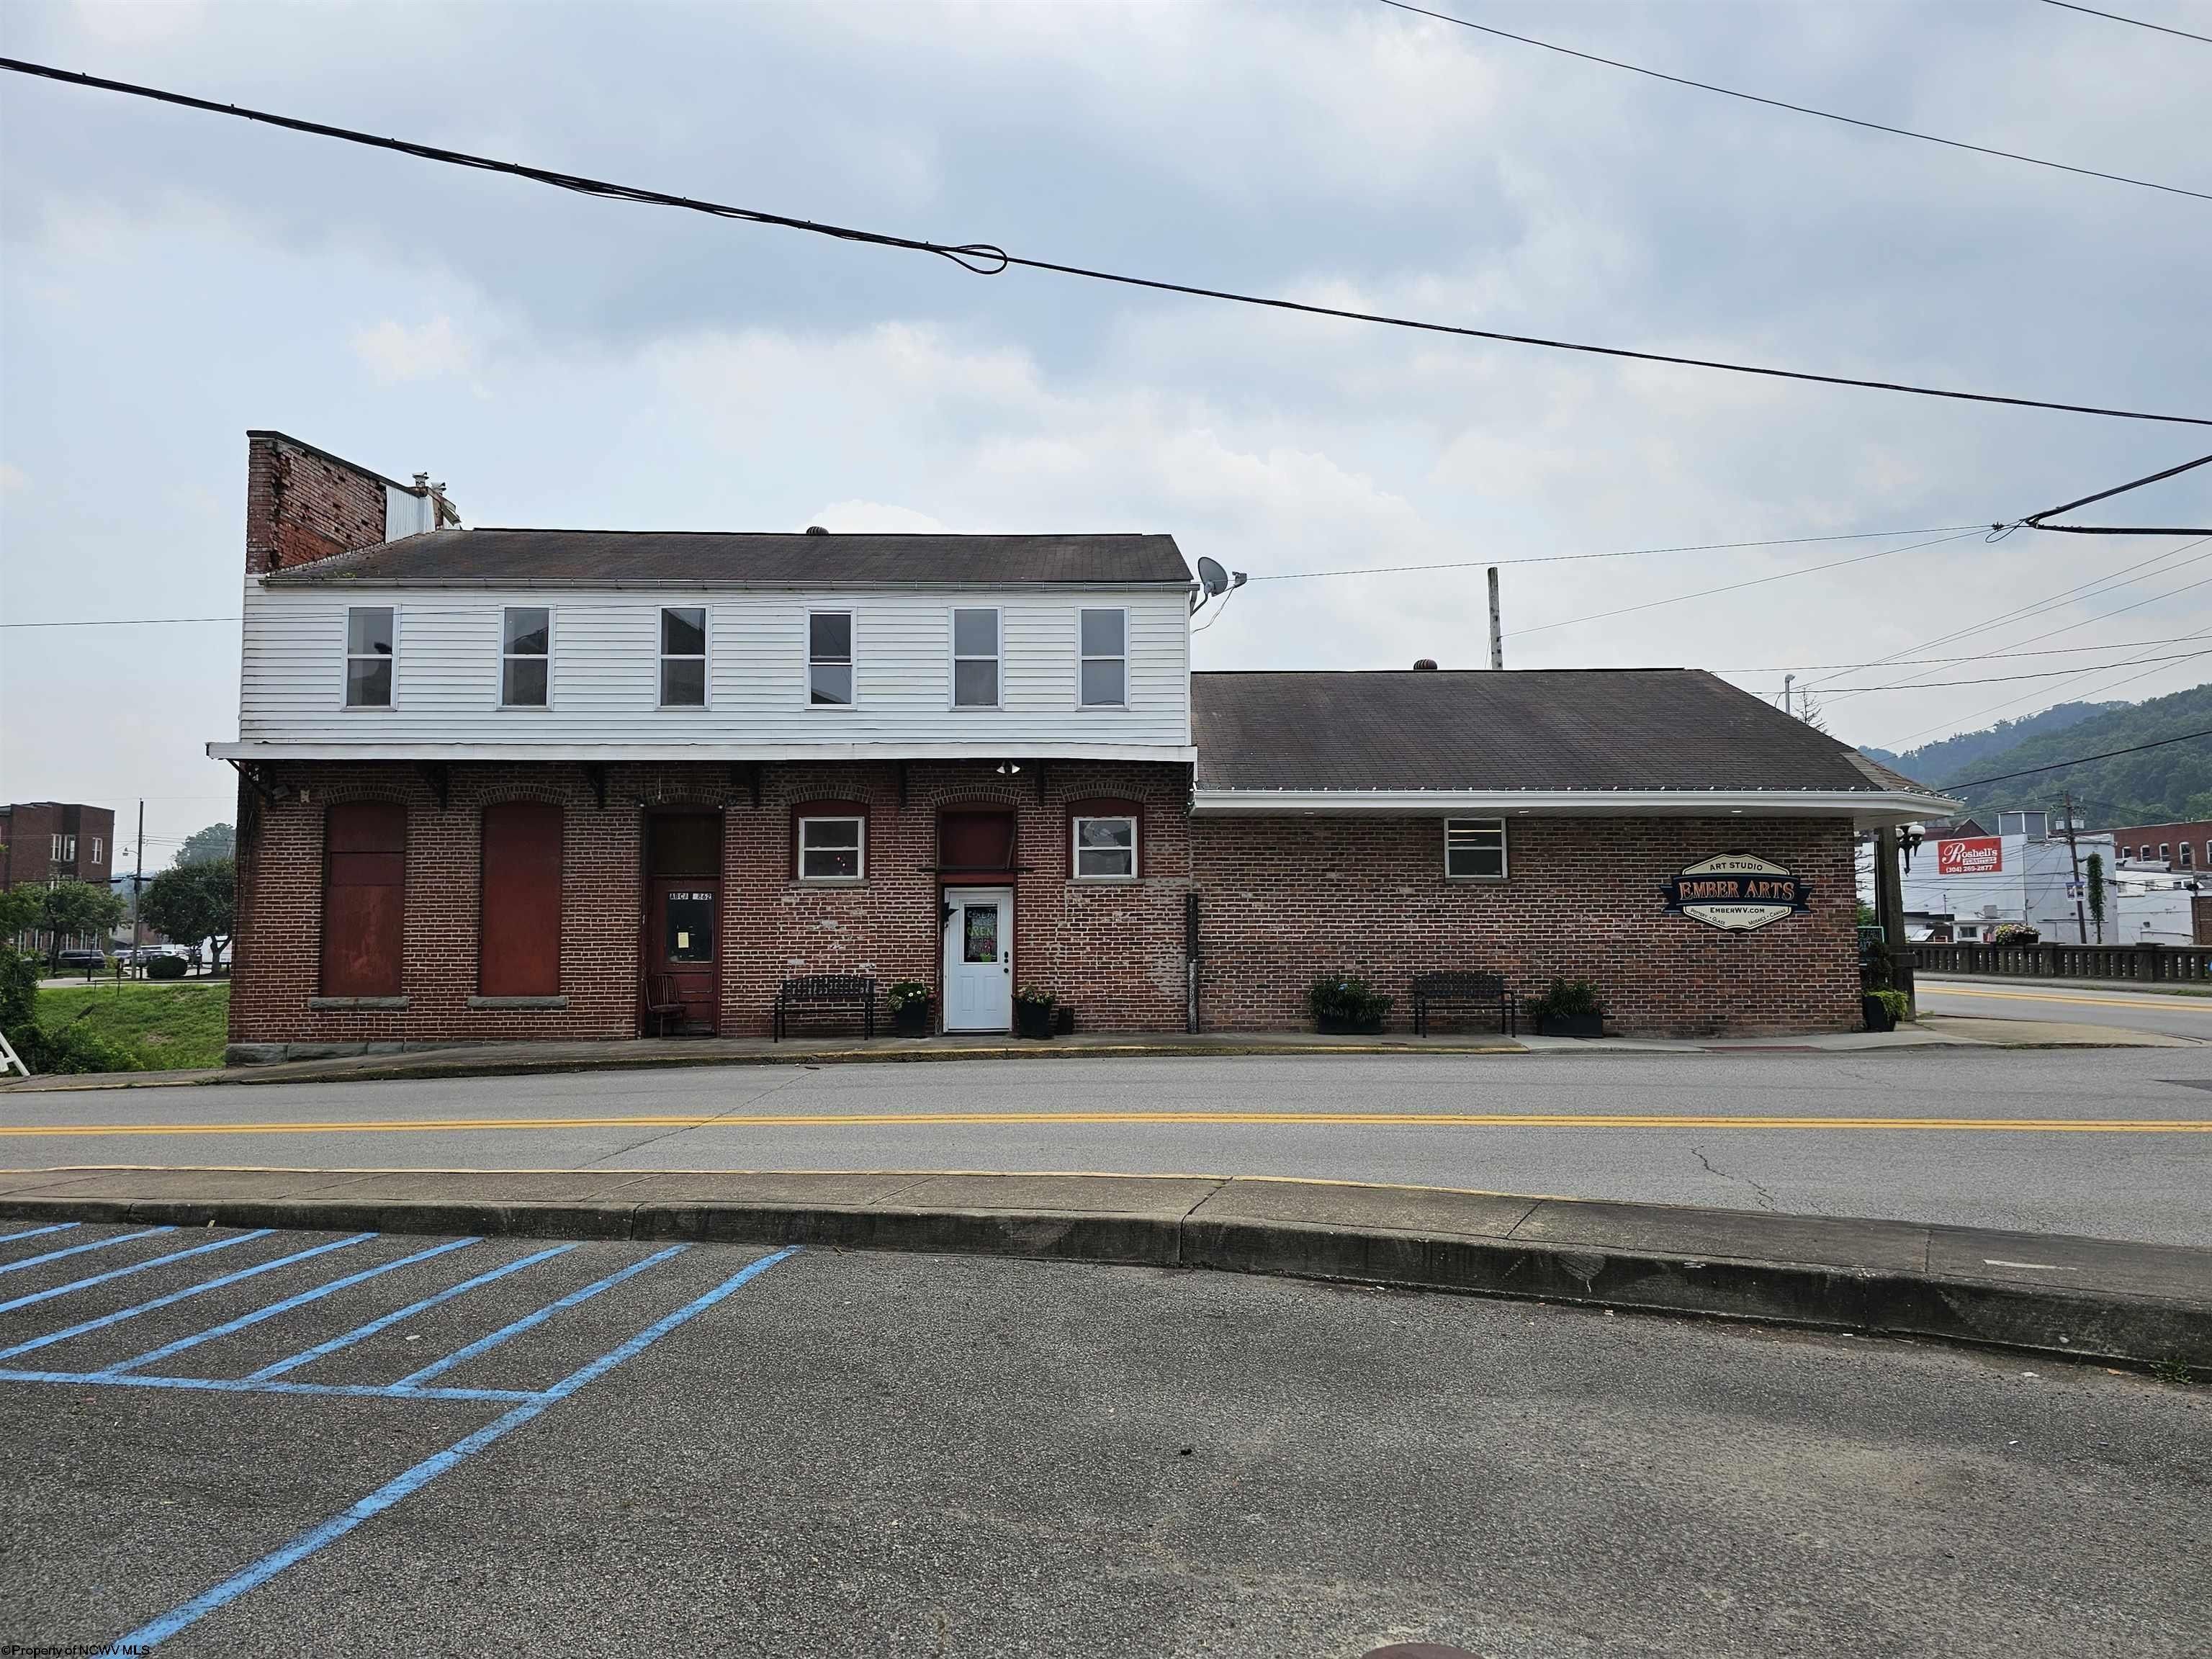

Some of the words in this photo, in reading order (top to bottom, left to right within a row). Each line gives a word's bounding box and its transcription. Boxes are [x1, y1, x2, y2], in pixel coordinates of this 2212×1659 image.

[1941, 842, 1998, 864] Roshell's
[1730, 862, 1763, 871] STUDIO
[1678, 881, 1740, 900] EMBER
[1744, 880, 1795, 900] ARTS
